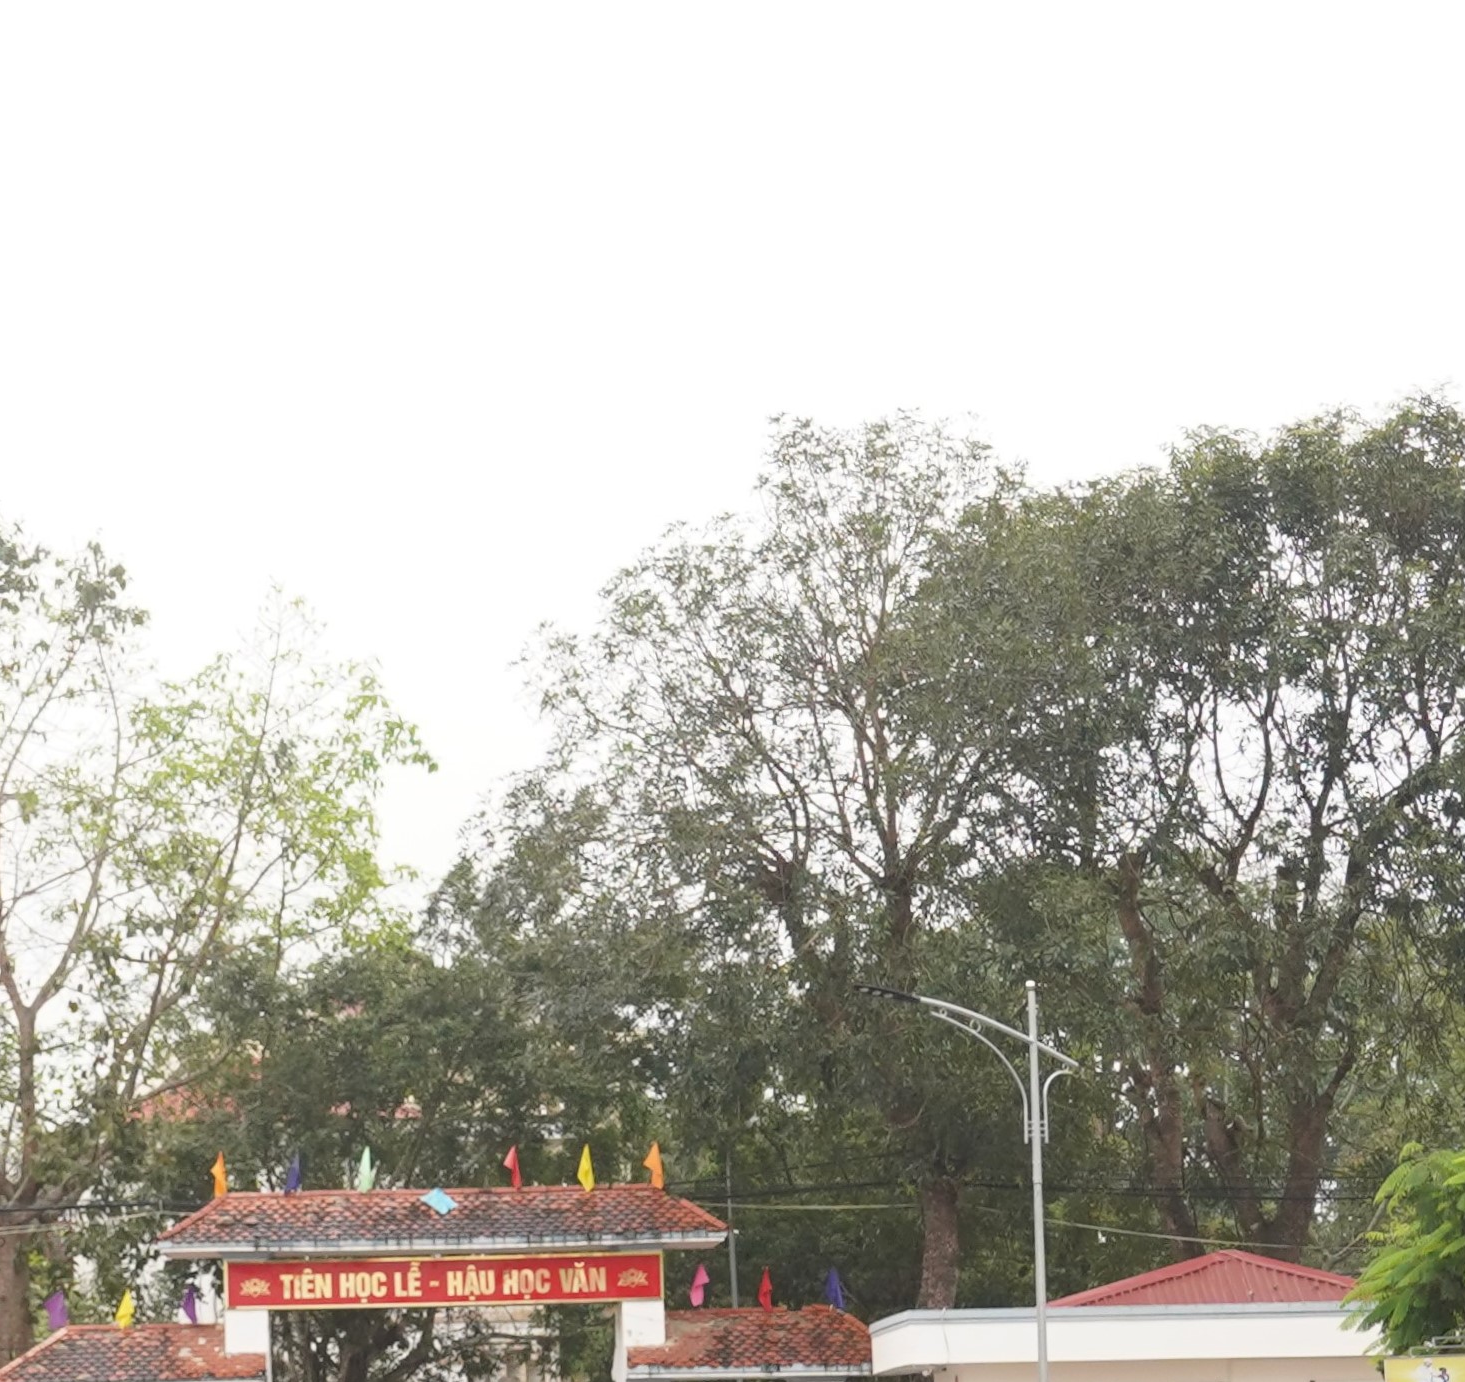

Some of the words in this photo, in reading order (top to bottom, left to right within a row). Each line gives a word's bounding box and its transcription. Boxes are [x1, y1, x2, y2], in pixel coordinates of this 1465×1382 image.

[279, 1268, 333, 1300] TIÊN
[339, 1271, 388, 1303] HỌC
[394, 1261, 423, 1297] LỄ
[446, 1264, 496, 1301] HẬU
[502, 1268, 551, 1300] HỌC
[558, 1261, 607, 1294] VĂN
